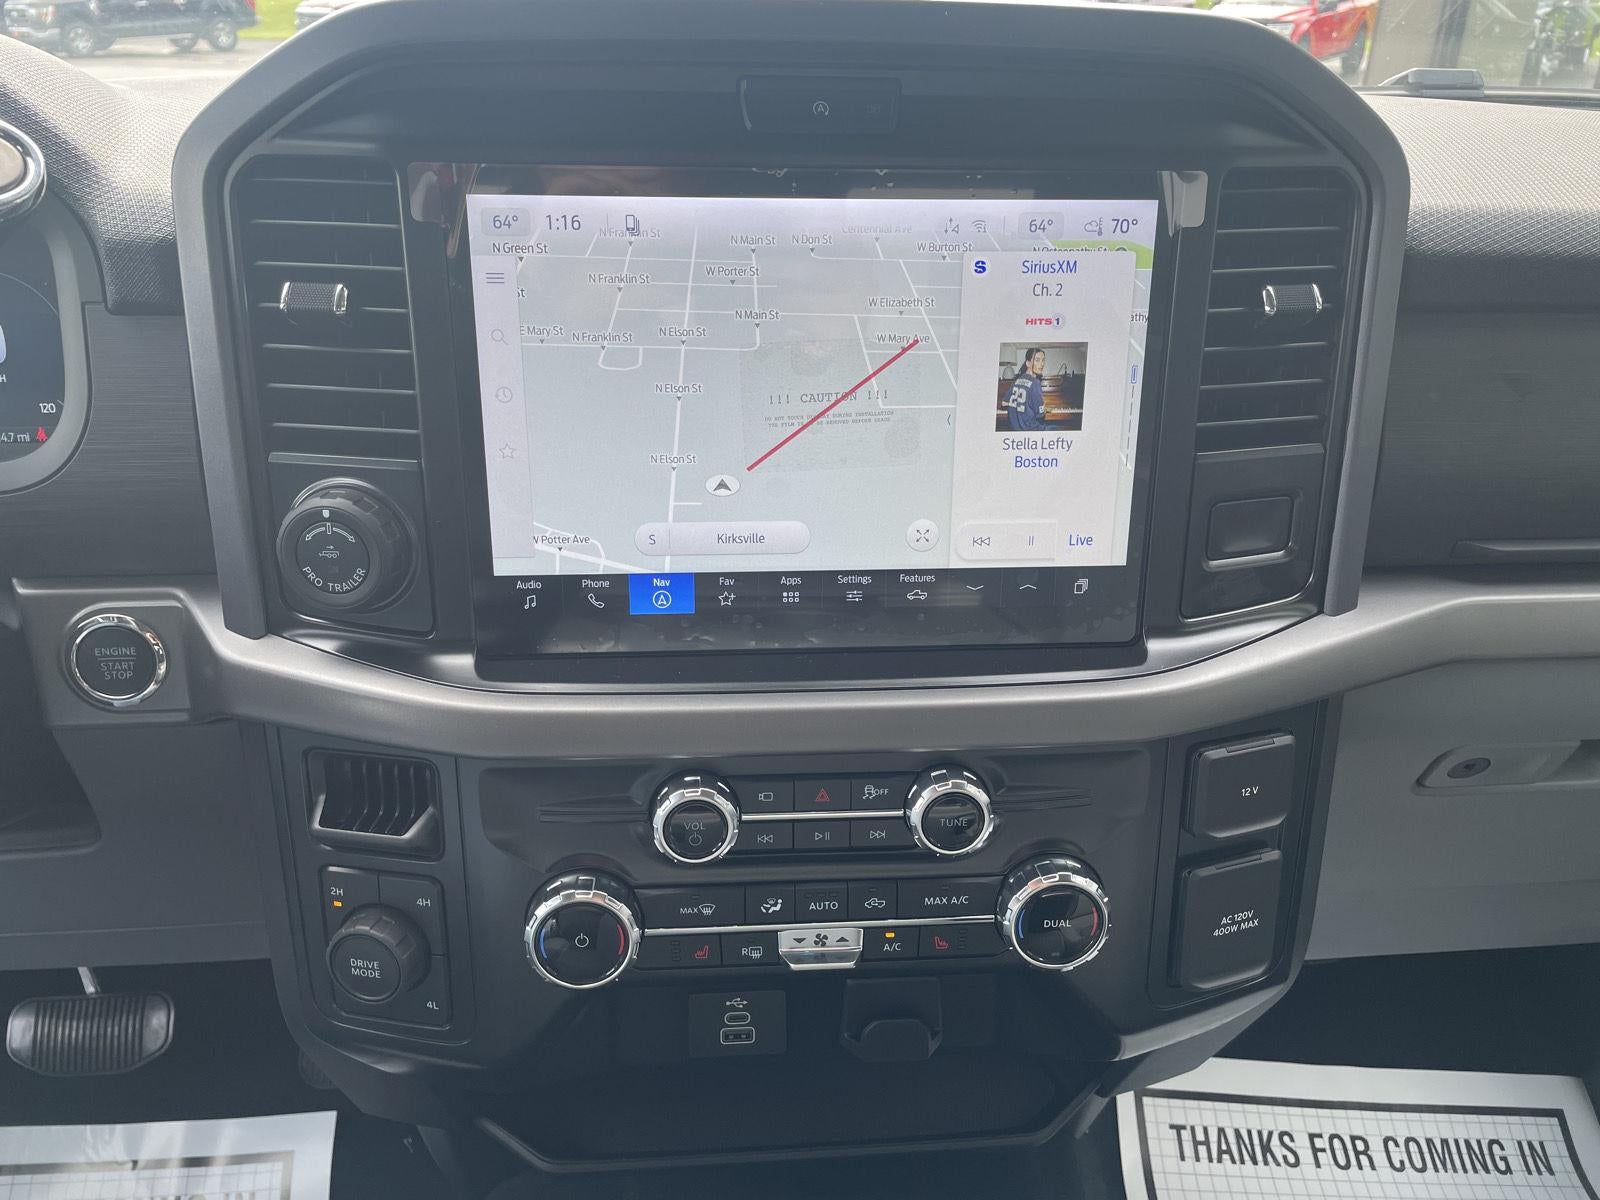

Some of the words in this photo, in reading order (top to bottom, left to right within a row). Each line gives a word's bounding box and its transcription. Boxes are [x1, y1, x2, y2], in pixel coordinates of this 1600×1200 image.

[492, 214, 519, 230] 64°
[545, 214, 582, 231] 1:16
[1028, 218, 1054, 233] 64°
[1111, 217, 1139, 234] 70°
[731, 235, 738, 245] N
[740, 234, 764, 245] Main
[765, 235, 776, 245] St
[792, 234, 799, 244] N
[801, 234, 821, 244] Don
[822, 234, 833, 244] St
[492, 242, 501, 254] N
[503, 242, 534, 254] Green
[536, 242, 549, 254] St
[916, 242, 927, 252] W
[929, 241, 961, 252] Burton
[962, 241, 973, 252] St
[705, 266, 716, 277] W
[718, 266, 748, 277] Porter
[749, 266, 760, 277] St
[1022, 260, 1078, 274] SiriusXM
[588, 274, 596, 284] N
[598, 273, 638, 284] Franklin
[639, 273, 650, 284] St
[1033, 283, 1052, 297] Ch.
[1055, 283, 1063, 297] 2
[868, 298, 878, 308] W
[880, 297, 923, 308] Elizabeth
[925, 297, 935, 308] St
[735, 310, 743, 320] N
[744, 309, 767, 320] Main
[769, 309, 780, 320] St
[1025, 317, 1053, 326] HITS
[527, 326, 551, 338] Mary
[553, 325, 564, 336] St
[659, 327, 667, 337] N
[669, 326, 695, 337] Elson
[696, 326, 707, 337] St
[572, 332, 580, 343] N
[582, 332, 621, 343] Franklin
[622, 332, 633, 343] St
[877, 334, 886, 344] W
[888, 333, 911, 346] Mary
[913, 333, 930, 344] Ave
[655, 384, 663, 394] N
[665, 383, 691, 394] Elson
[692, 383, 702, 394] St
[39, 402, 56, 414] 120
[17, 432, 30, 443] mi
[1002, 437, 1038, 451] Stella
[1041, 437, 1073, 452] Lefty
[651, 454, 659, 464] N
[661, 454, 685, 464] Elson
[686, 454, 697, 464] St
[1014, 455, 1058, 468] Boston
[541, 535, 571, 544] Potter
[572, 534, 590, 544] Ave
[649, 534, 656, 545] S
[717, 533, 766, 545] Kirksville
[1069, 533, 1093, 547] Live
[302, 565, 324, 588] PRO
[327, 565, 367, 593] TRAILER
[582, 578, 610, 589] Phone
[653, 578, 670, 587] Nav
[719, 577, 735, 586] Fav
[780, 576, 802, 588] Apps
[837, 574, 872, 586] Settings
[899, 573, 936, 583] Features
[516, 579, 542, 590] Audio
[94, 646, 137, 657] ENGINE
[100, 661, 135, 671] START
[104, 671, 134, 681] STOP
[873, 787, 889, 797] OFF
[1241, 786, 1251, 797] 12
[1252, 785, 1260, 796] V
[683, 822, 706, 831] VOL
[940, 818, 968, 828] TUNE
[330, 886, 344, 897] 2H
[416, 898, 431, 908] 4H
[809, 901, 839, 911] AUTO
[924, 896, 948, 906] MAX
[950, 895, 969, 905] A/C
[680, 906, 699, 915] MAX
[1221, 914, 1234, 926] AC
[1234, 909, 1255, 923] 120V
[1043, 919, 1072, 929] DUAL
[1213, 923, 1239, 938] 400W
[1239, 917, 1260, 931] MAX
[883, 942, 902, 952] A/C
[350, 958, 380, 970] DRIVE
[351, 967, 382, 979] MODE
[426, 1000, 440, 1010] 4L
[1168, 1122, 1301, 1170] THANKS
[1307, 1132, 1377, 1172] FOR
[1382, 1135, 1513, 1177] COMING
[1516, 1139, 1557, 1177] IN
